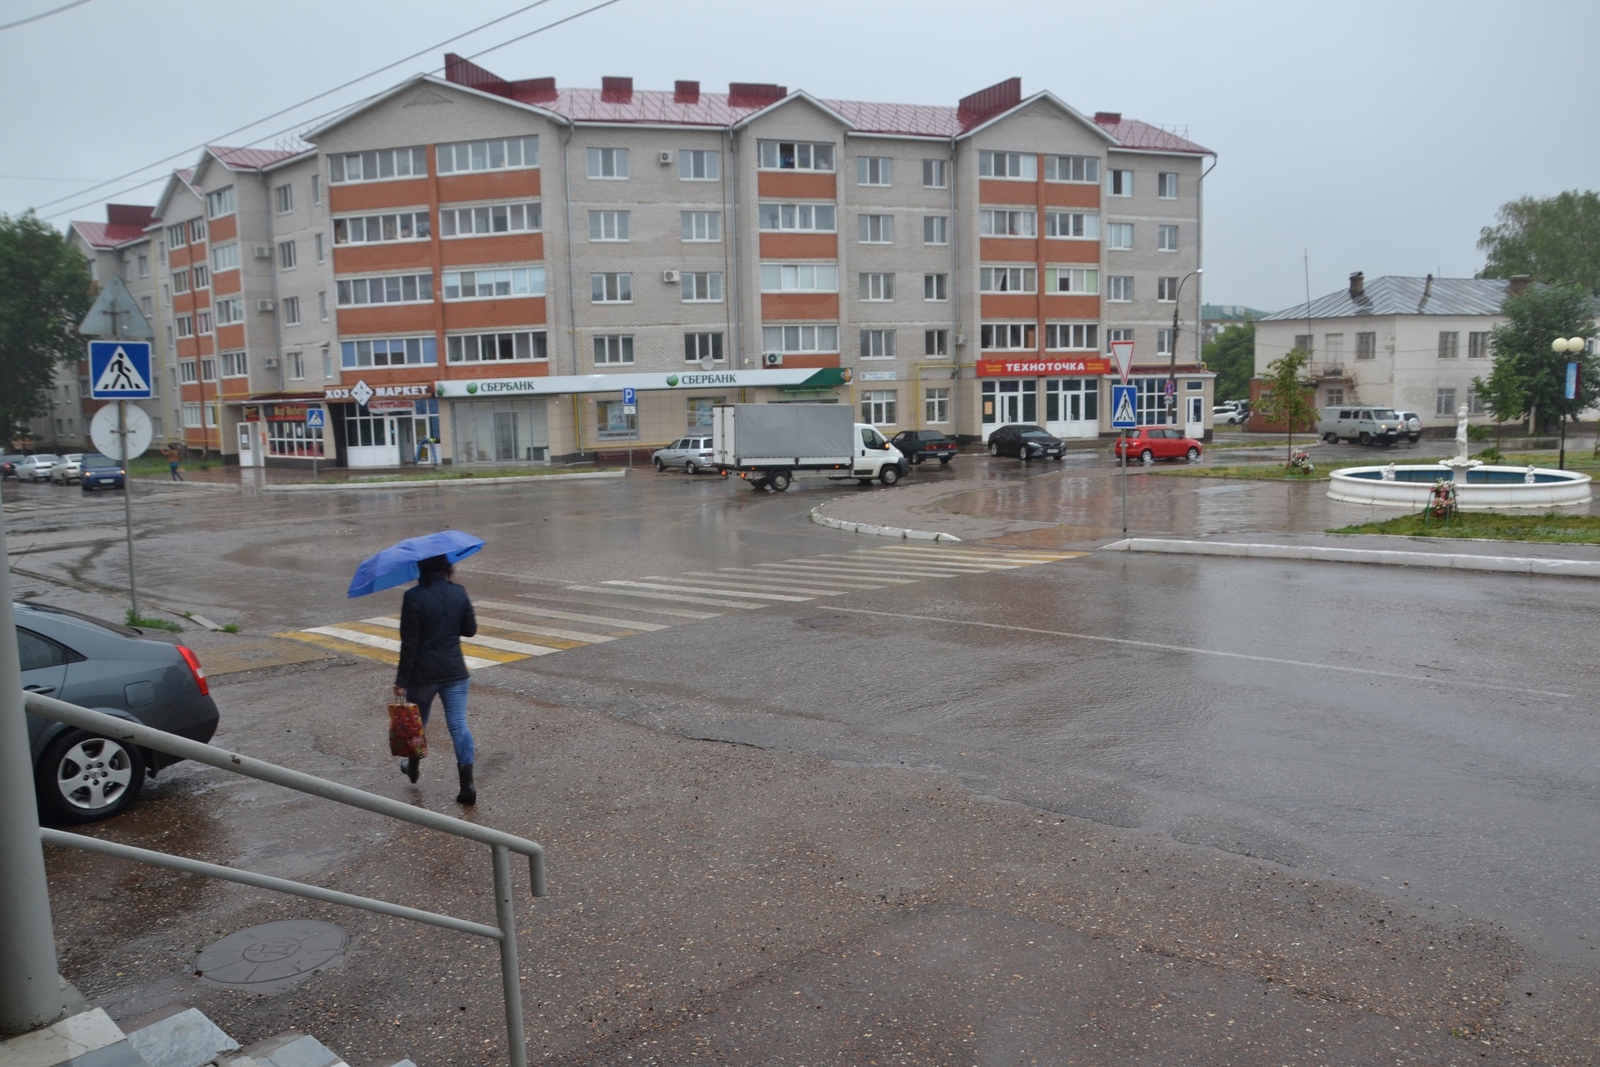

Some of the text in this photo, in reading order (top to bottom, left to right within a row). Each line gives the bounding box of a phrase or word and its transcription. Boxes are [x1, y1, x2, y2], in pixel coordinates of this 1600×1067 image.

[1006, 362, 1085, 372] ТЕХНОТОЧКА
[681, 374, 737, 385] СБЕРБАНК
[325, 385, 428, 399] ХОЗ МАРКЕТ
[480, 381, 535, 392] СБЕРБАНК
